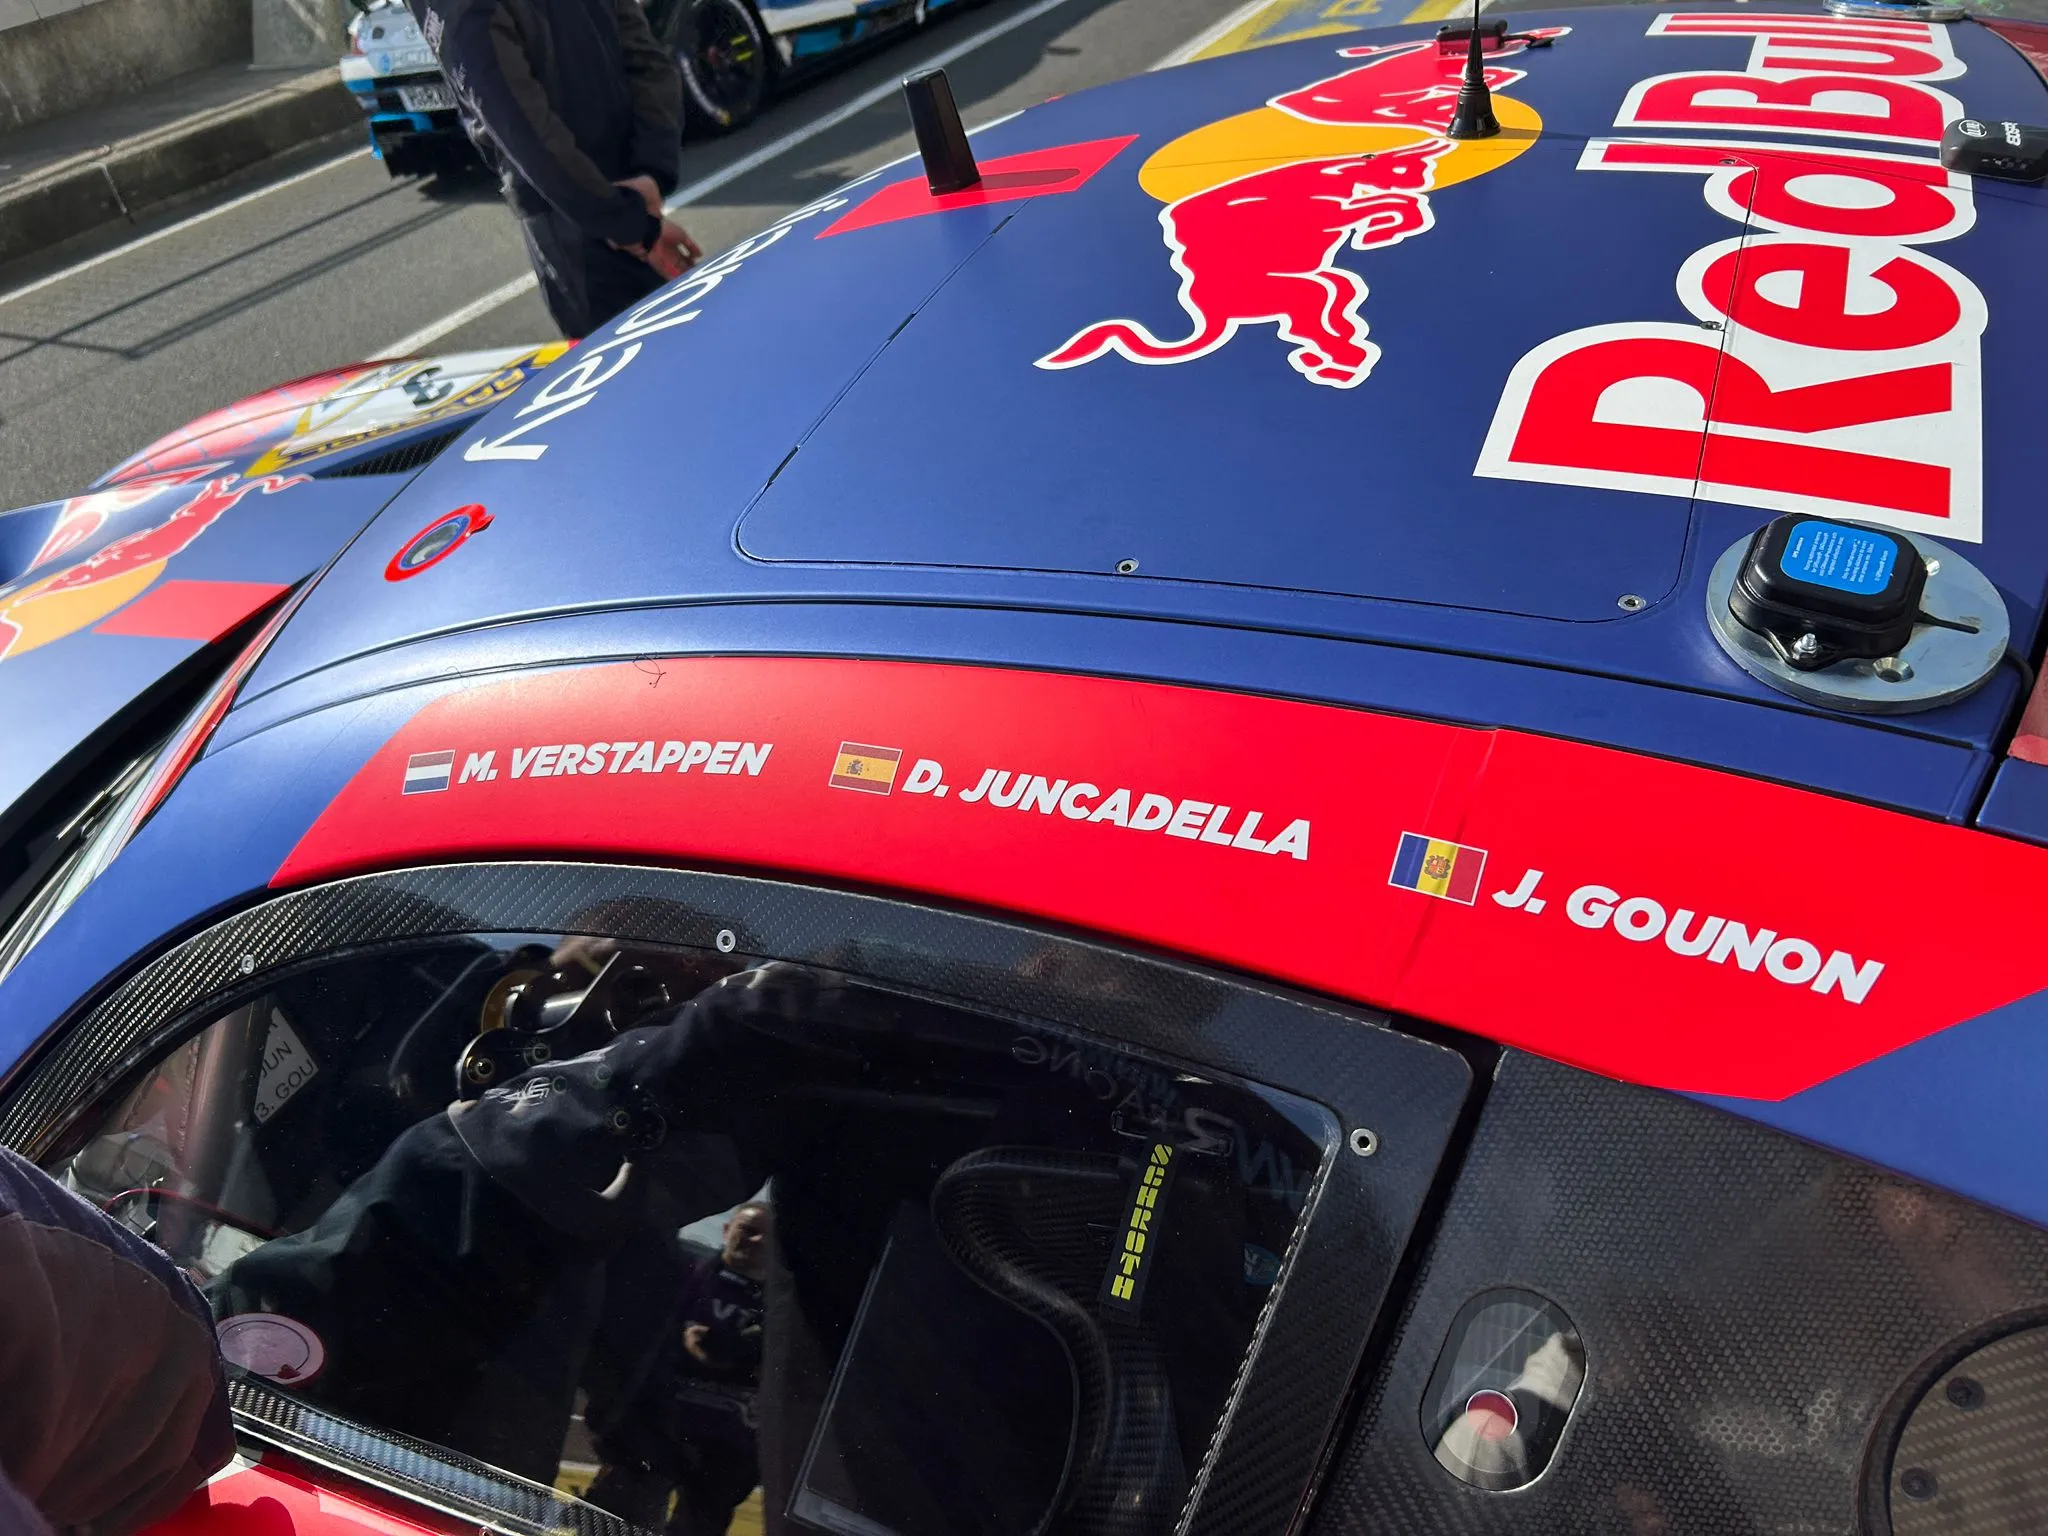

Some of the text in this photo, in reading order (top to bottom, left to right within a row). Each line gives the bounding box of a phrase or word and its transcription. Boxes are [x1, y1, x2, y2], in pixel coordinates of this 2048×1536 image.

[1500, 140, 1968, 525] Red
[457, 740, 774, 784] M. VERSTAPPEN
[902, 758, 1312, 861] D. JUNCADELLA
[1491, 868, 1886, 1005] J. GOUNON
[1110, 1142, 1174, 1302] SCHROTH
